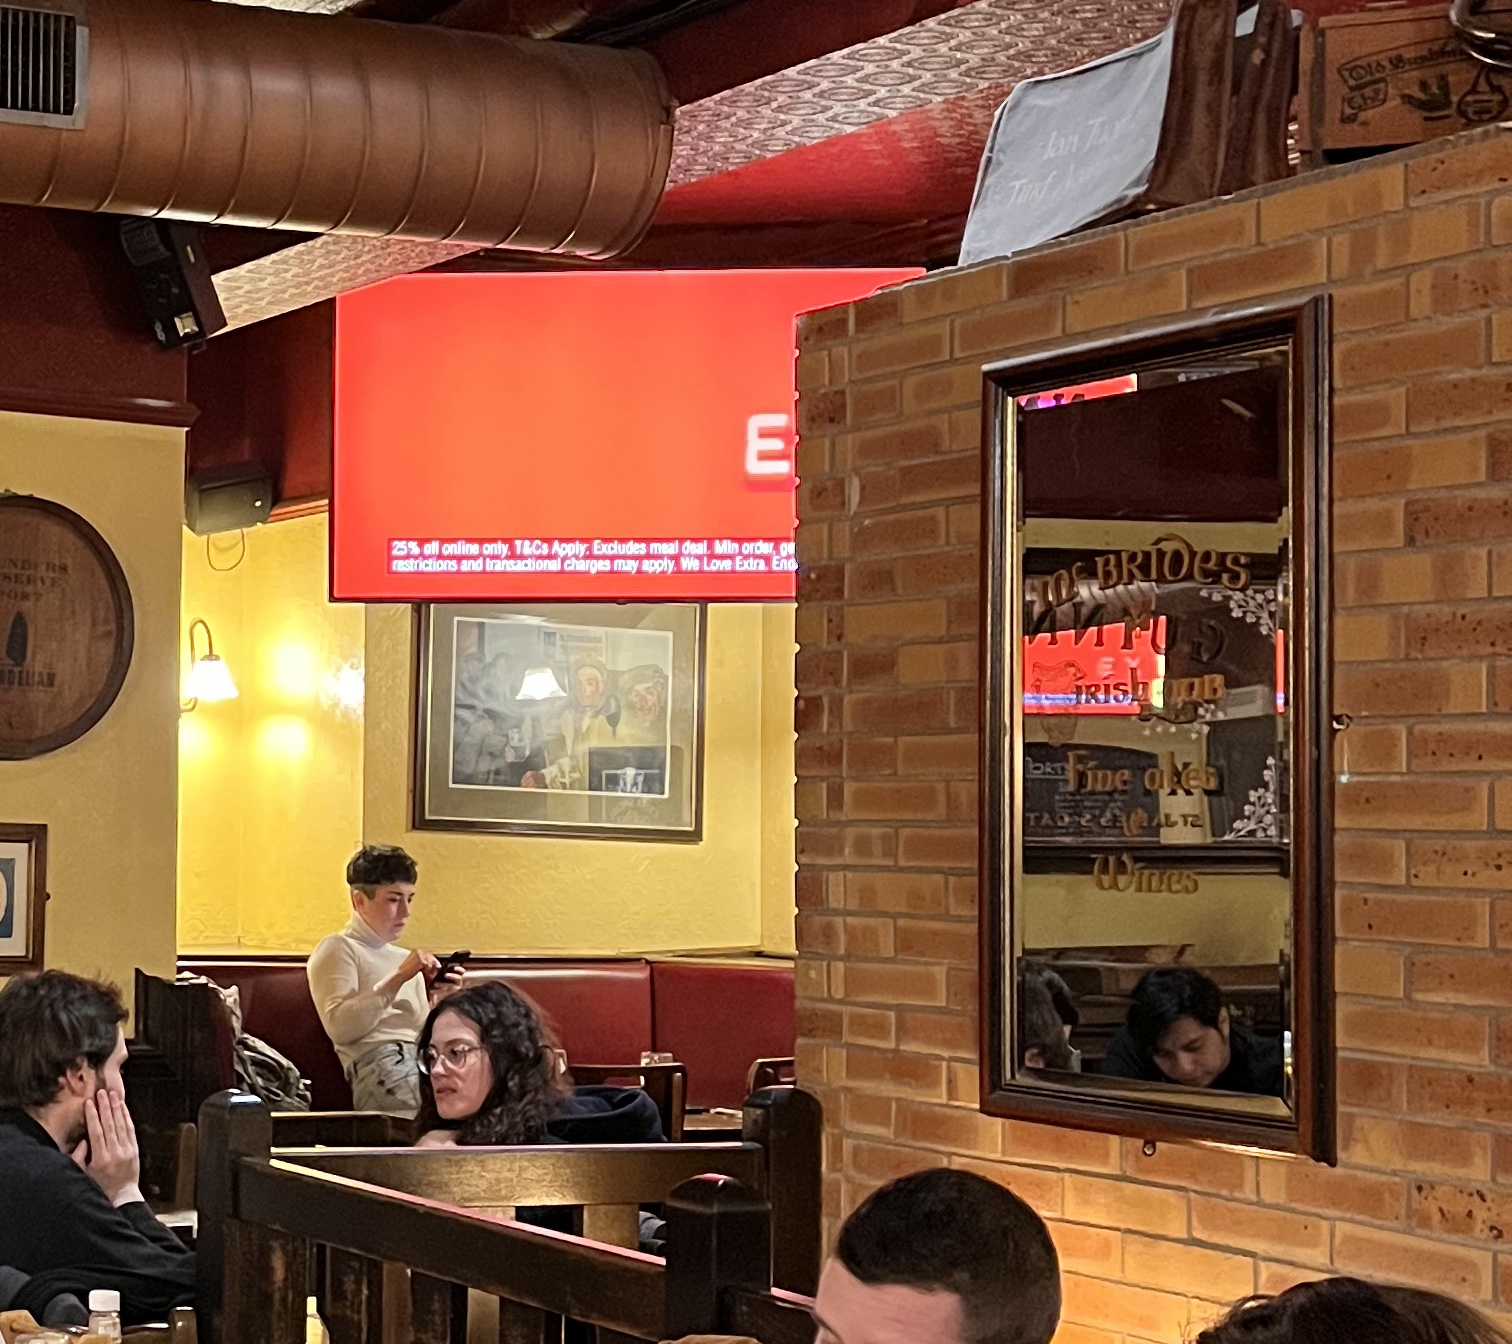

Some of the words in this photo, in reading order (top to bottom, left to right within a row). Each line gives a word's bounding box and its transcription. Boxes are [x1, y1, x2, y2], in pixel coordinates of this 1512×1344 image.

[392, 540, 420, 555] 25%
[442, 540, 479, 555] online
[514, 540, 548, 555] T&Cs
[594, 540, 646, 555] Excludes
[650, 540, 678, 555] meal
[715, 540, 738, 555] Min
[392, 557, 457, 571] restrictions
[460, 558, 483, 571] and
[486, 558, 561, 571] transactional
[564, 558, 610, 574] charges
[613, 560, 639, 574] may
[680, 557, 700, 570] We
[704, 557, 732, 570] Love
